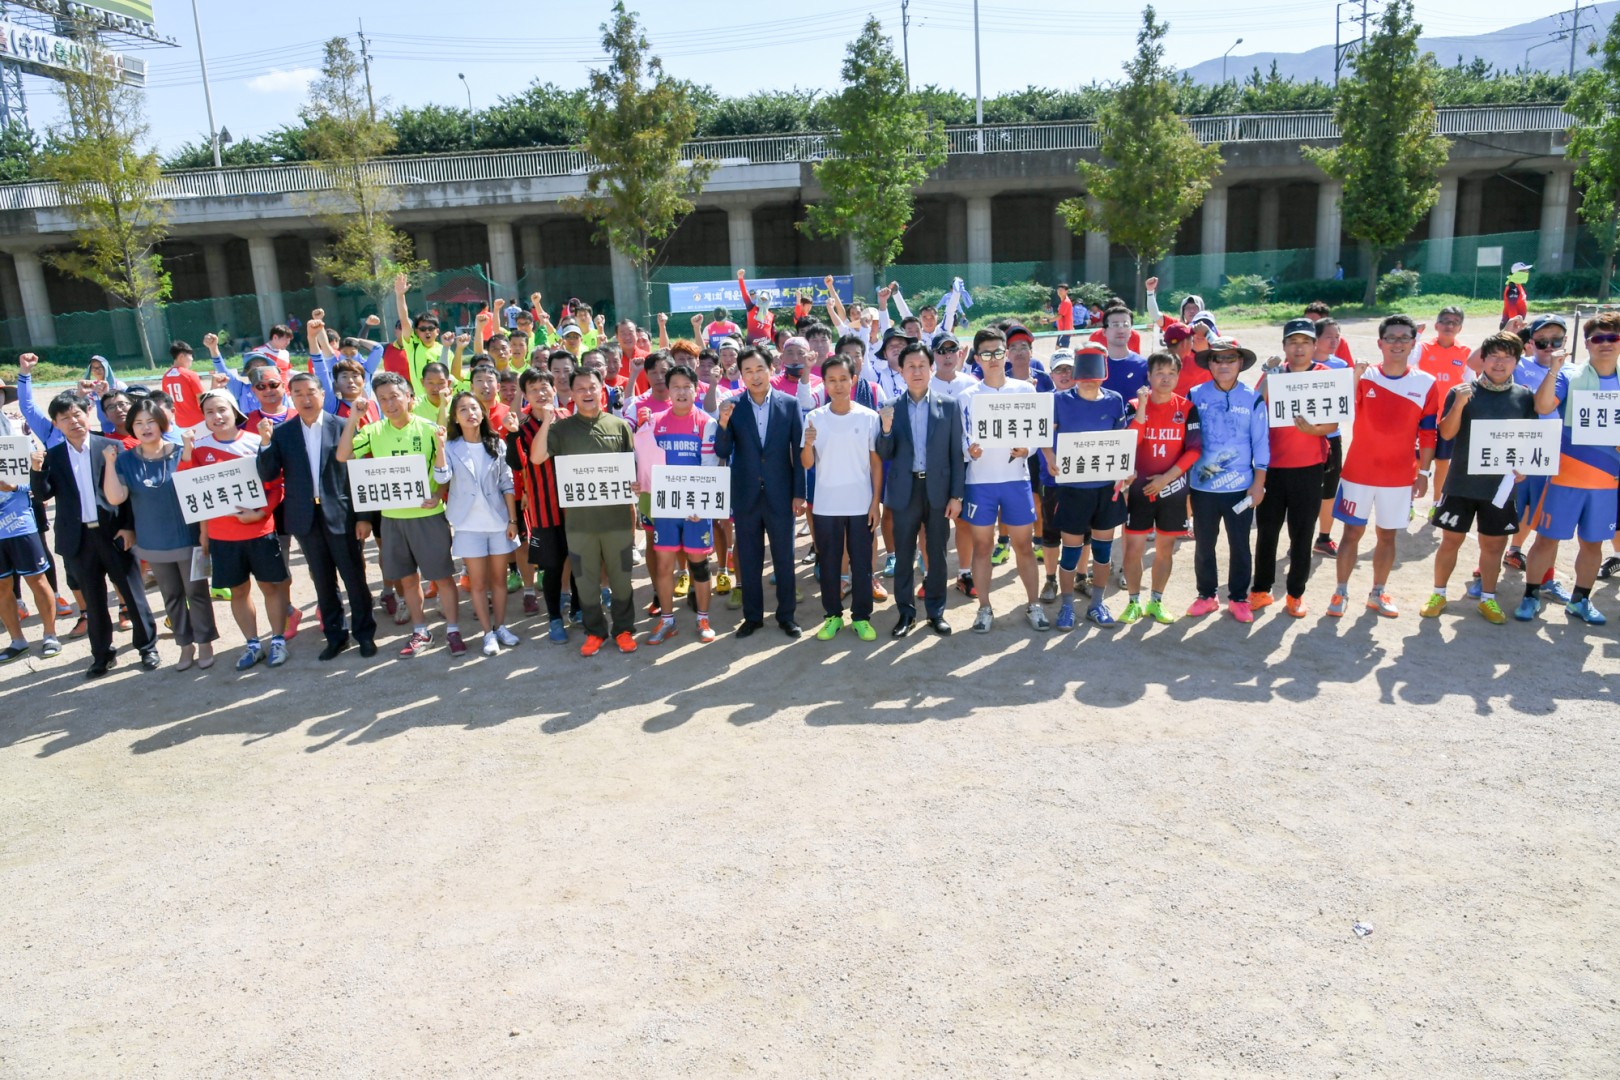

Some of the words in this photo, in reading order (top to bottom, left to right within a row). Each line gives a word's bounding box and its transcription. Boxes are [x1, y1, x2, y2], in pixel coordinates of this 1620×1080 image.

[1437, 372, 1450, 381] 10
[167, 383, 184, 402] 19
[1275, 396, 1348, 420] 마린족구회
[978, 418, 1048, 439] 현대족구회
[1159, 428, 1182, 440] KILL
[658, 440, 672, 450] SEA
[673, 440, 699, 452] HORSE
[1152, 443, 1166, 458] 14
[1062, 453, 1130, 474] 청솔족구회
[185, 480, 260, 513] 장산족구단
[357, 480, 426, 504] 울타리족구회
[564, 480, 632, 502] 일공오족구단
[656, 490, 724, 510] 해마족구회
[967, 502, 978, 519] 17
[1439, 511, 1460, 528] 44
